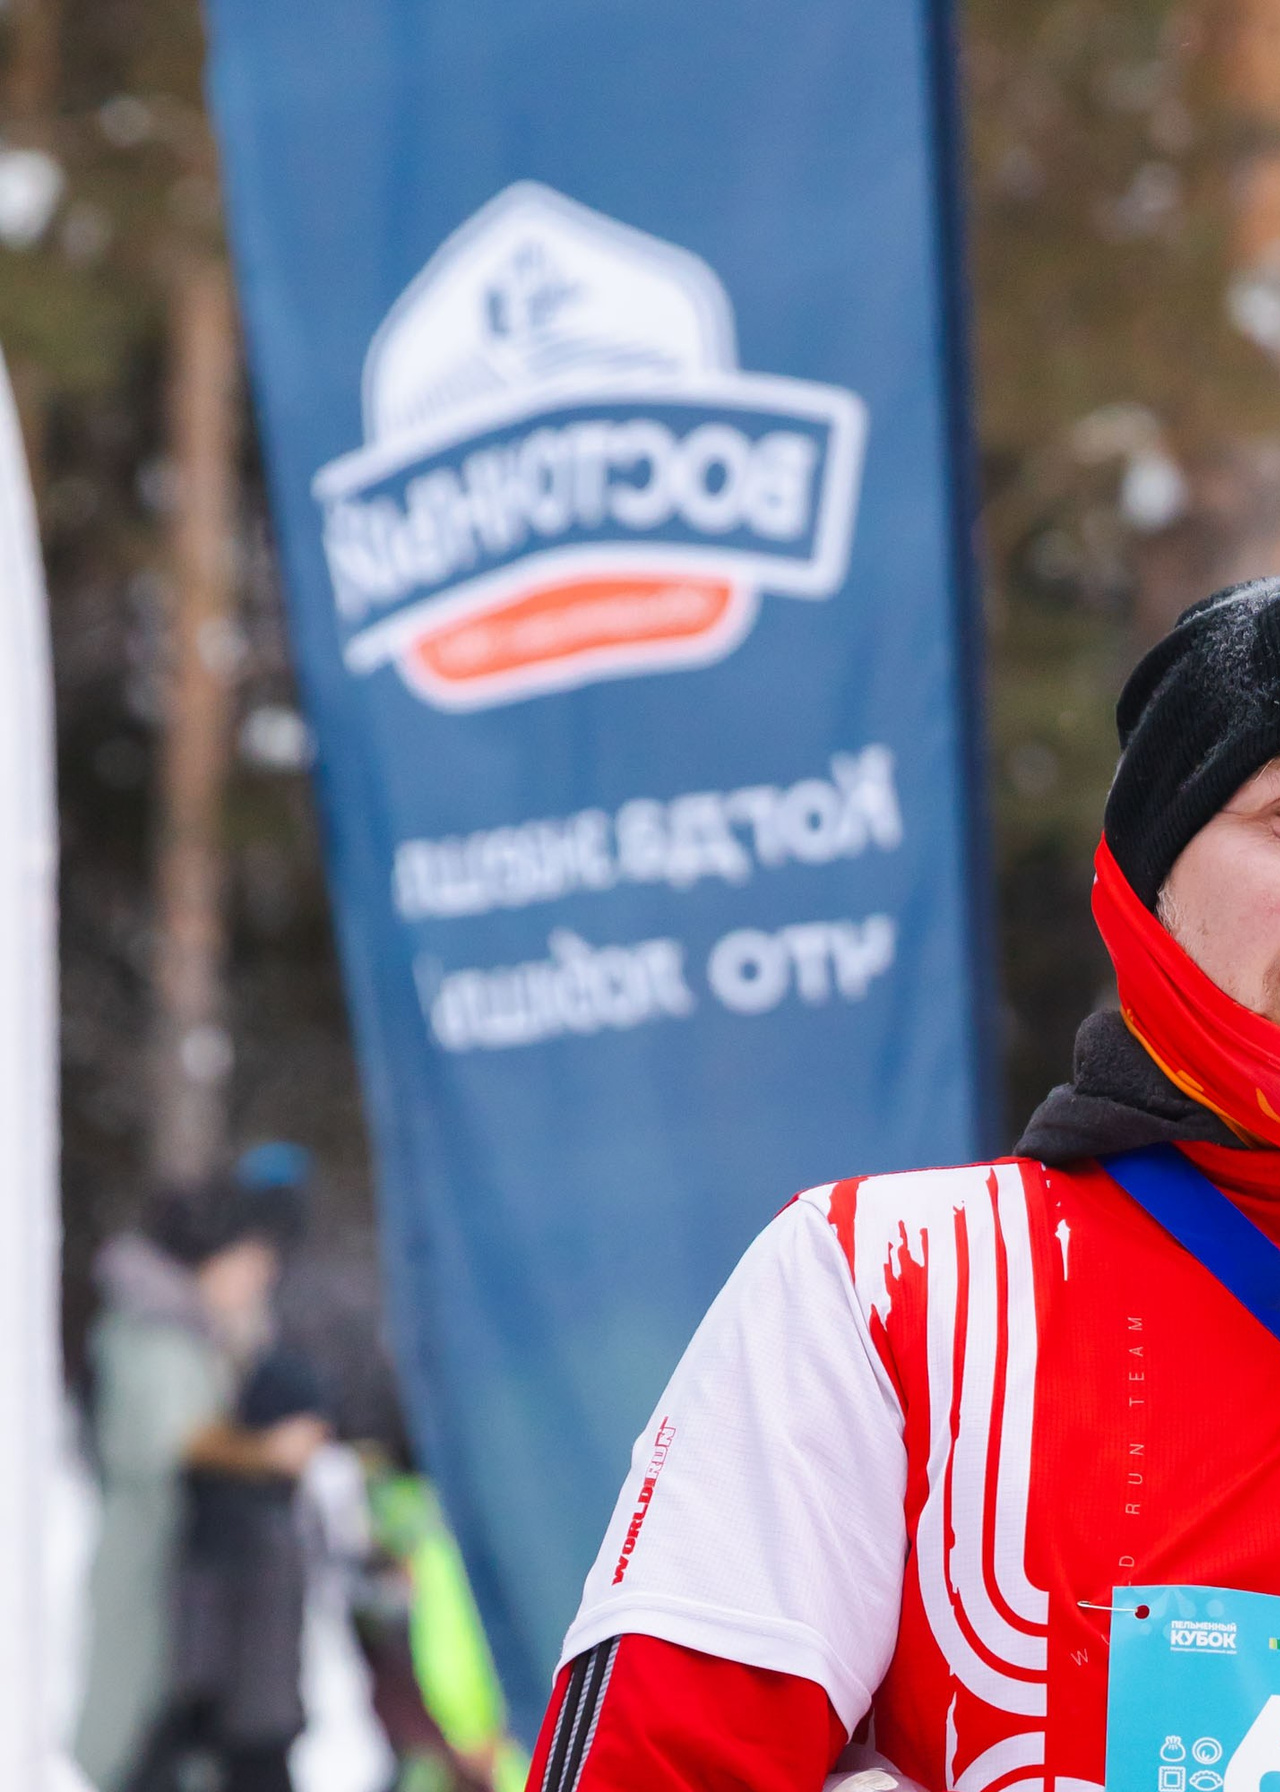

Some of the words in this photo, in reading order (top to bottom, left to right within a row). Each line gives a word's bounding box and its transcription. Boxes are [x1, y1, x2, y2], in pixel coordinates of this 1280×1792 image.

[1128, 1316, 1145, 1406] TEAM
[1125, 1442, 1144, 1515] RUN
[1170, 1630, 1236, 1649] КУБОК
[1171, 1620, 1237, 1632] ПЕЛЬМЕННЫЙ
